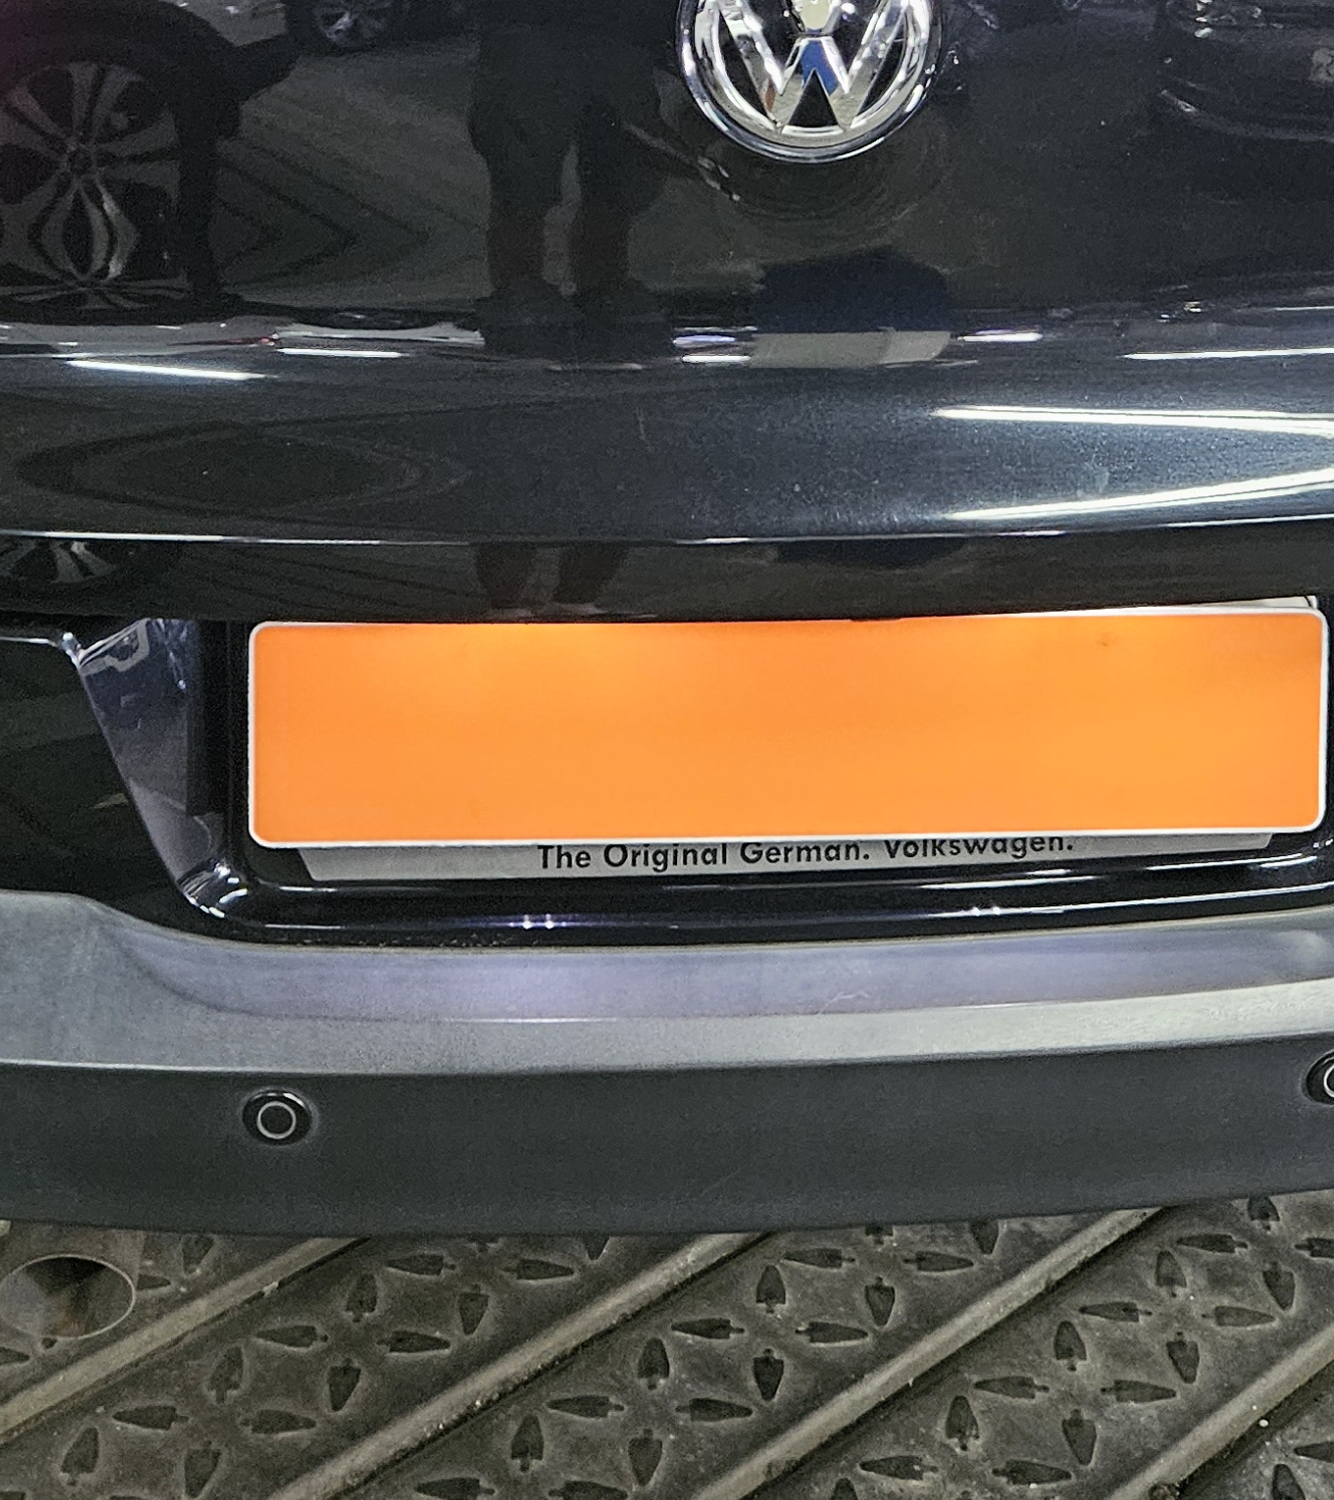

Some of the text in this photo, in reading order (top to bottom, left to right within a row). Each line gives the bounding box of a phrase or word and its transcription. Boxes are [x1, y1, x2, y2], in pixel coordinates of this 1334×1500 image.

[536, 844, 592, 870] The
[603, 842, 728, 873] Original
[740, 840, 870, 864] German.
